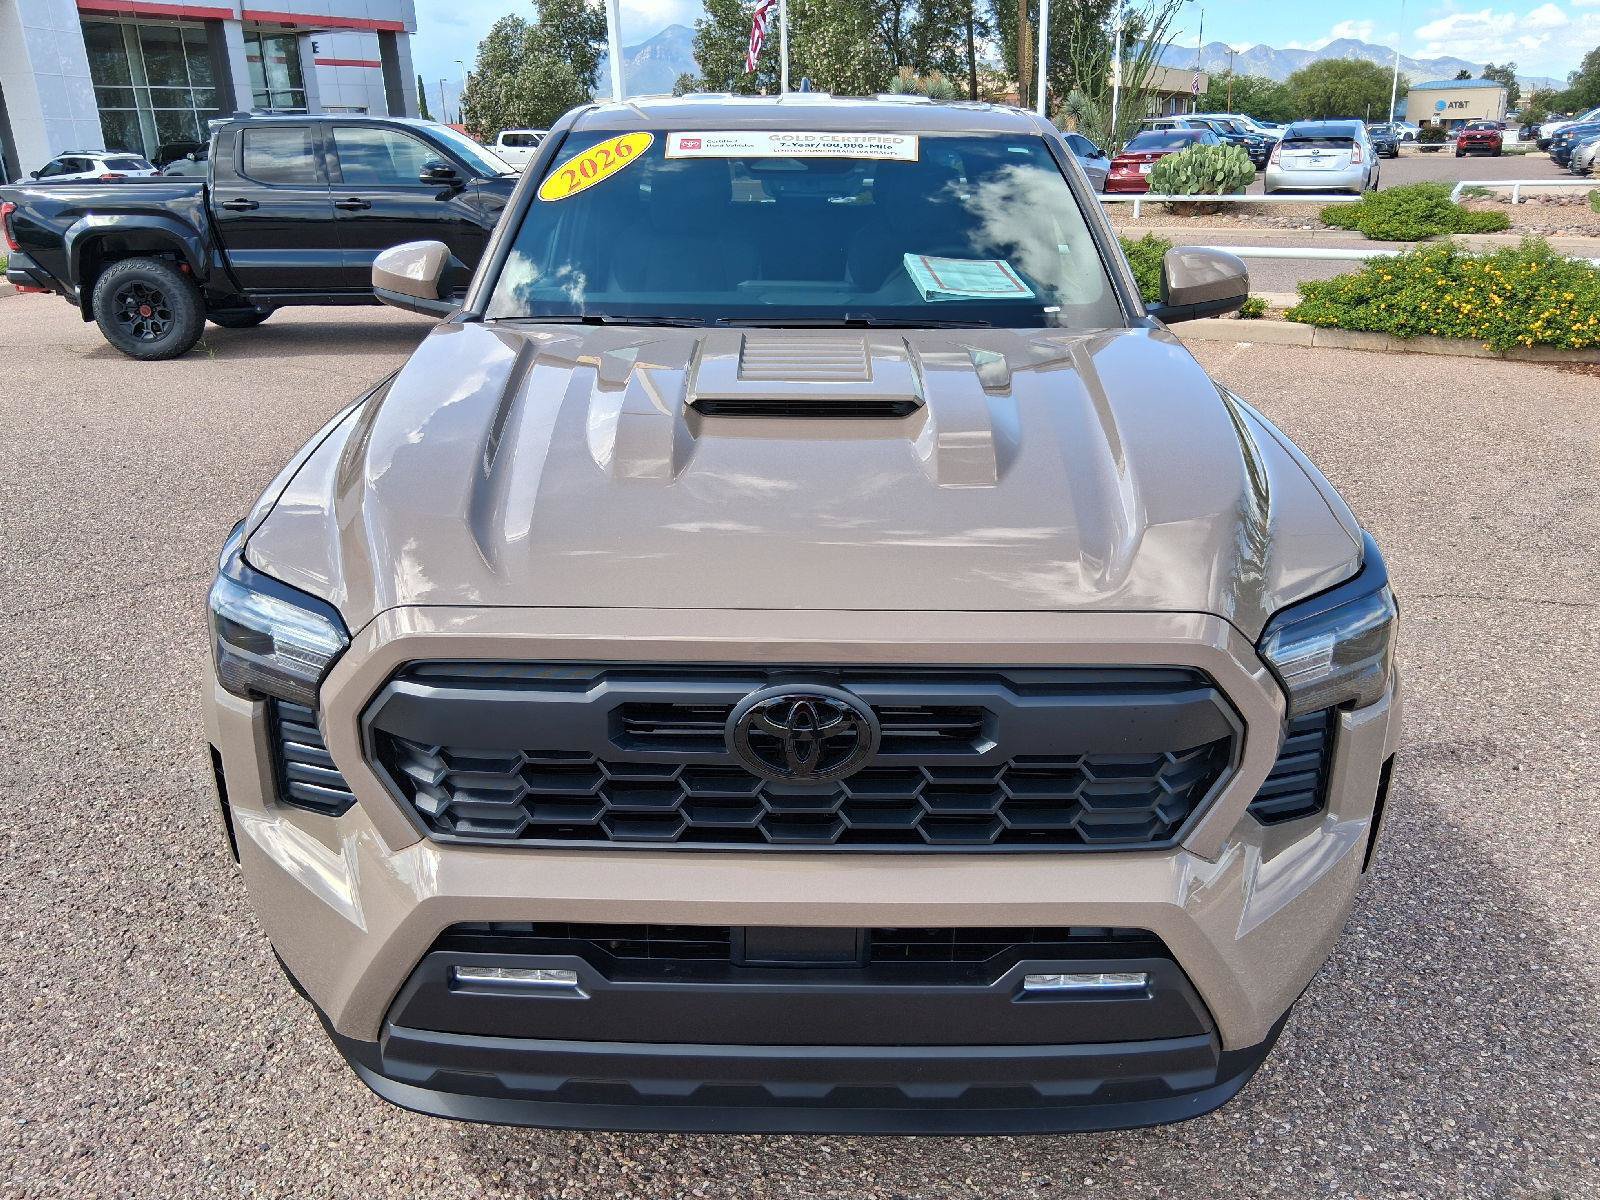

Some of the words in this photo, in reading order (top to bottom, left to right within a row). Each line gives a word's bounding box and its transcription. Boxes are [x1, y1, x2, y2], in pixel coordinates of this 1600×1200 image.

[1447, 100, 1470, 109] AT&T
[768, 134, 816, 142] GOLD
[819, 135, 905, 144] CERTIFIED
[560, 138, 633, 193] 2026
